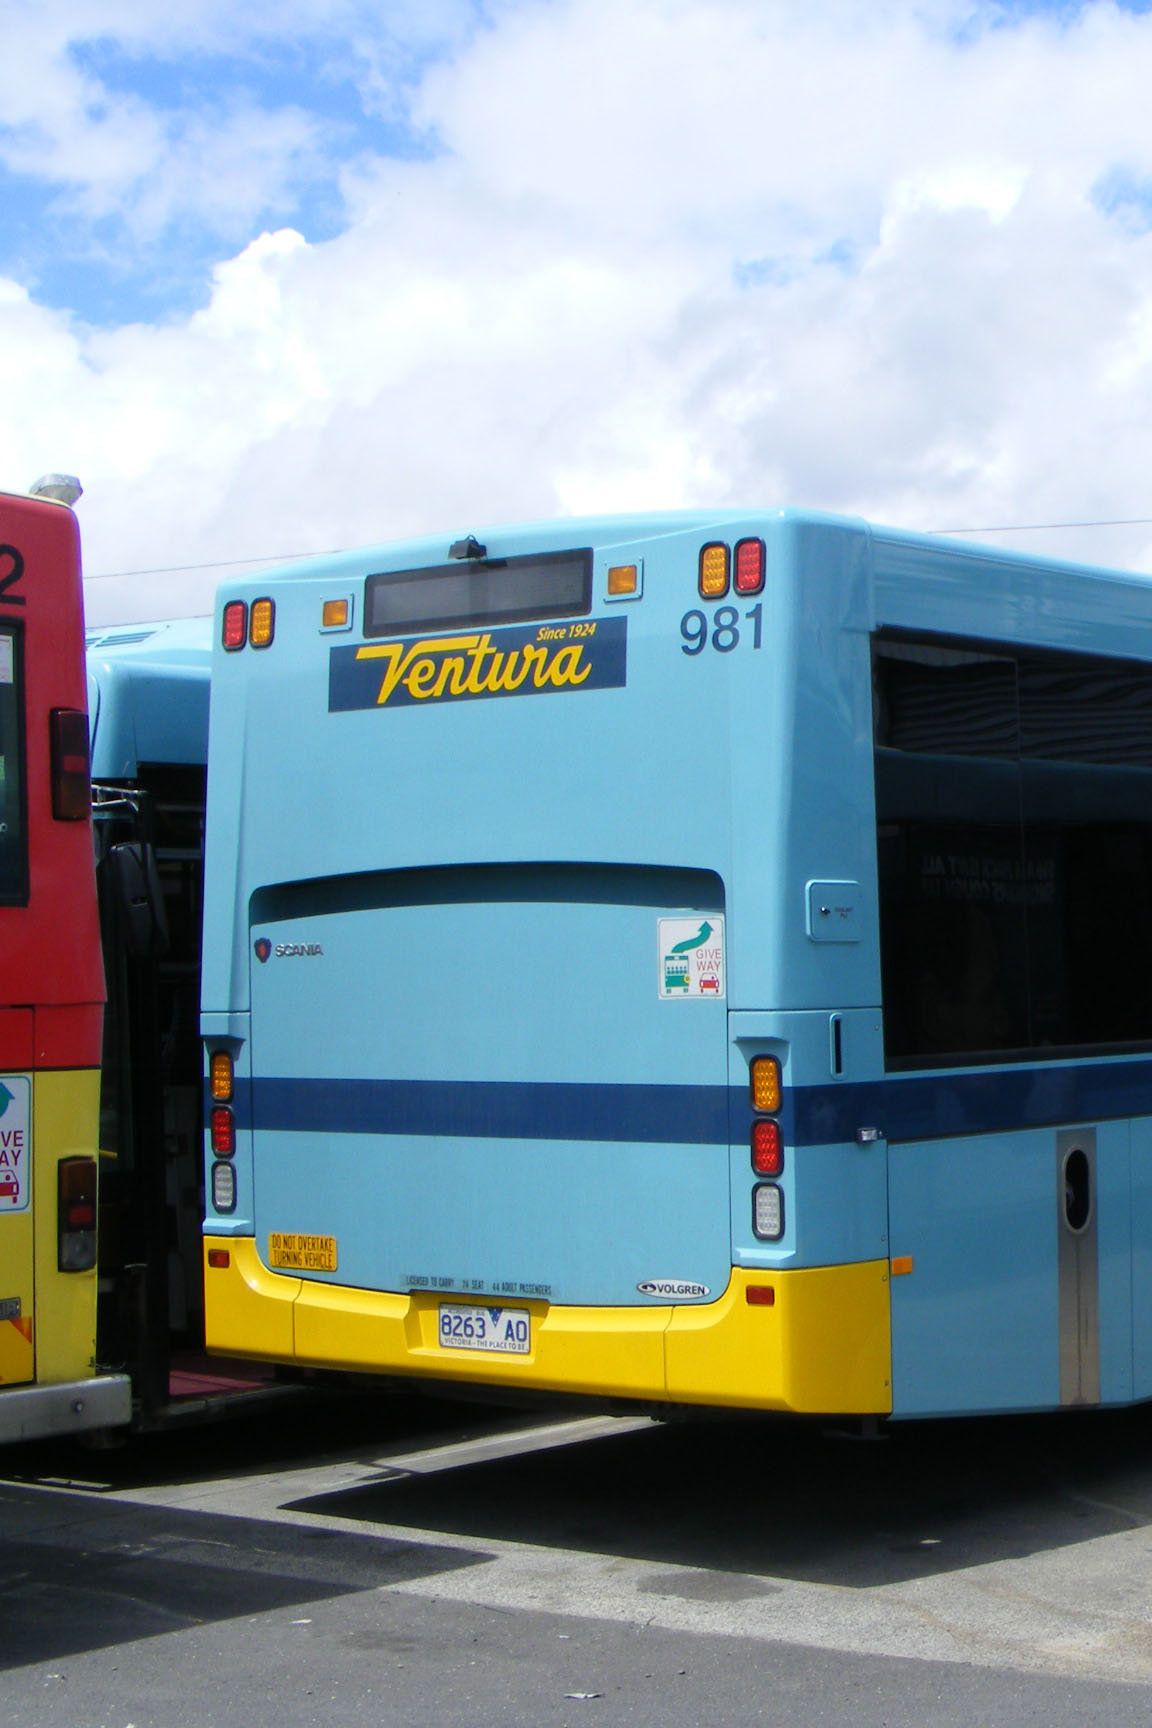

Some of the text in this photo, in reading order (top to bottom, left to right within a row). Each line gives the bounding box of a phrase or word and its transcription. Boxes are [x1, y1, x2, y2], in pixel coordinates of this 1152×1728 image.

[0, 543, 27, 606] 2
[536, 622, 597, 642] Since 1924
[680, 602, 763, 656] 981
[355, 633, 593, 705] Ventura
[275, 943, 325, 958] SCANIA
[695, 948, 722, 960] GIVE
[696, 960, 721, 972] WAY
[271, 1234, 334, 1253] DO NOT OVERTAKE
[273, 1250, 334, 1269] TURNING VEHICLE
[472, 1279, 484, 1290] SEAT
[520, 1283, 552, 1296] PASSENGERS
[656, 1283, 706, 1296] VOLGREN
[441, 1314, 486, 1339] 8263
[444, 1337, 472, 1346] VICTORIA
[476, 1340, 488, 1348] THE
[489, 1341, 508, 1349] PLACE
[508, 1342, 517, 1350] TO
[518, 1342, 526, 1350] BE
